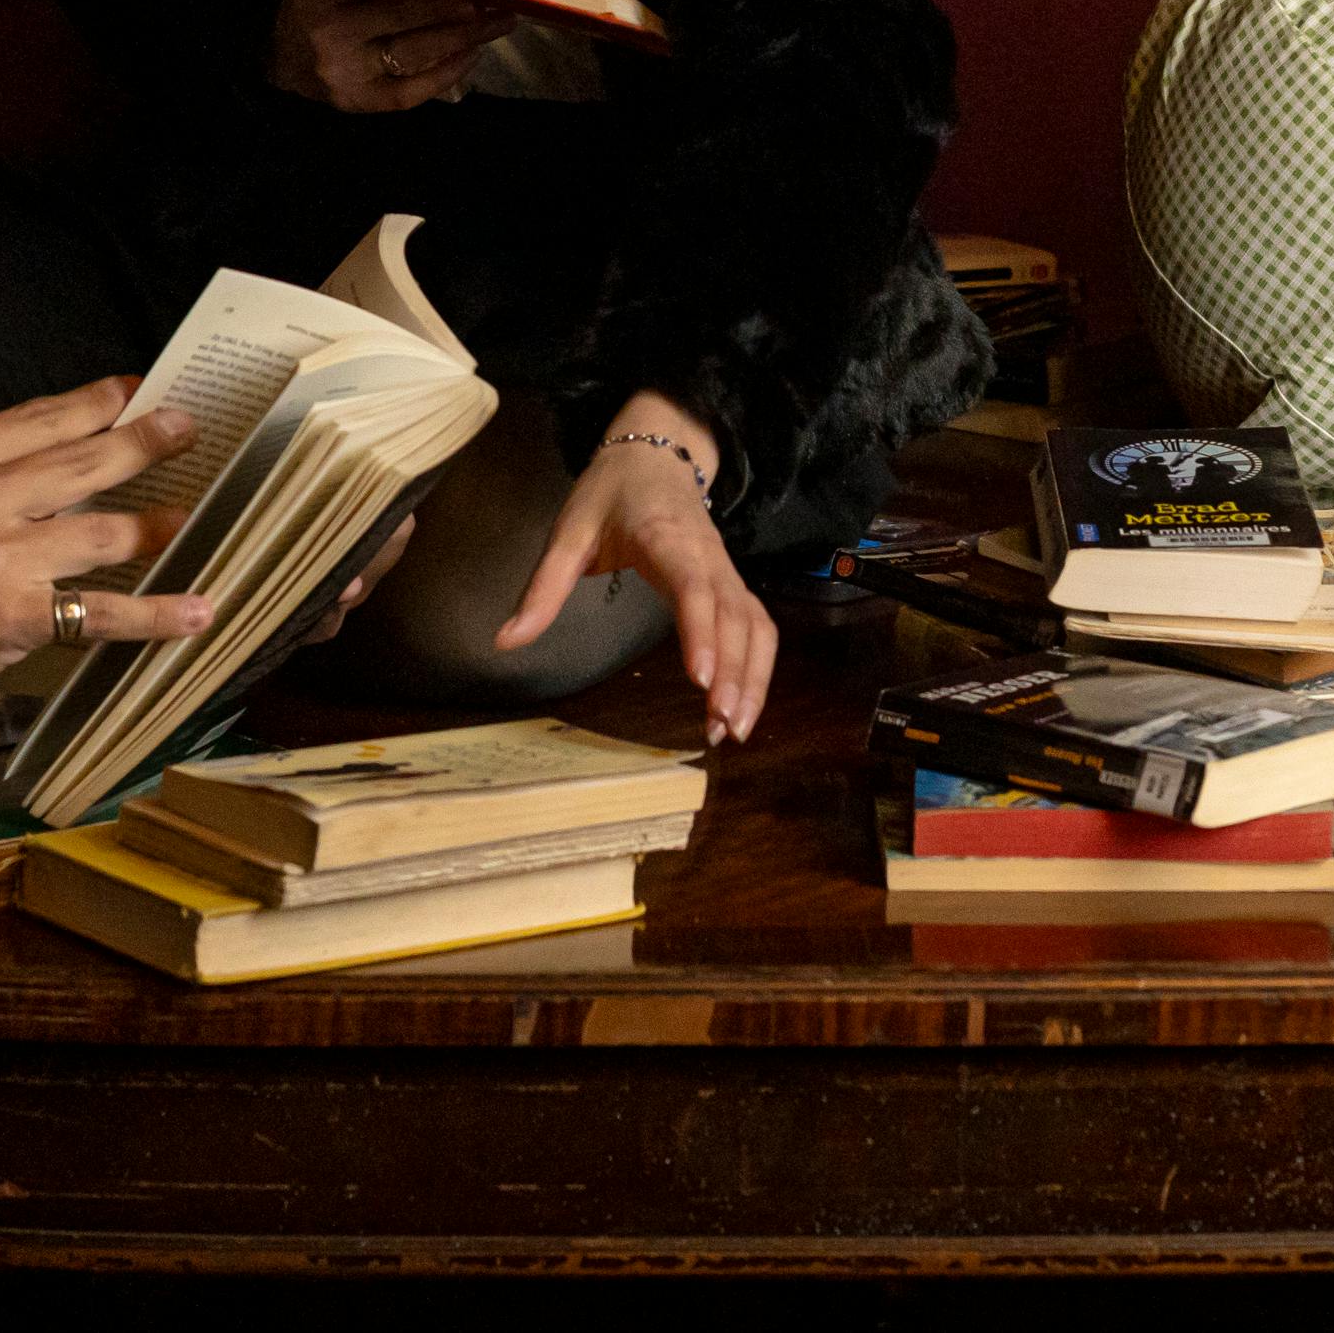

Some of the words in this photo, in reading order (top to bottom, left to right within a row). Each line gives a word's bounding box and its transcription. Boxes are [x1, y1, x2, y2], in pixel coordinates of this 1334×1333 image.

[1154, 501, 1239, 514] Brad
[1125, 513, 1271, 525] Meltzer
[1119, 527, 1153, 536] Les
[1159, 523, 1291, 536] millionnaires
